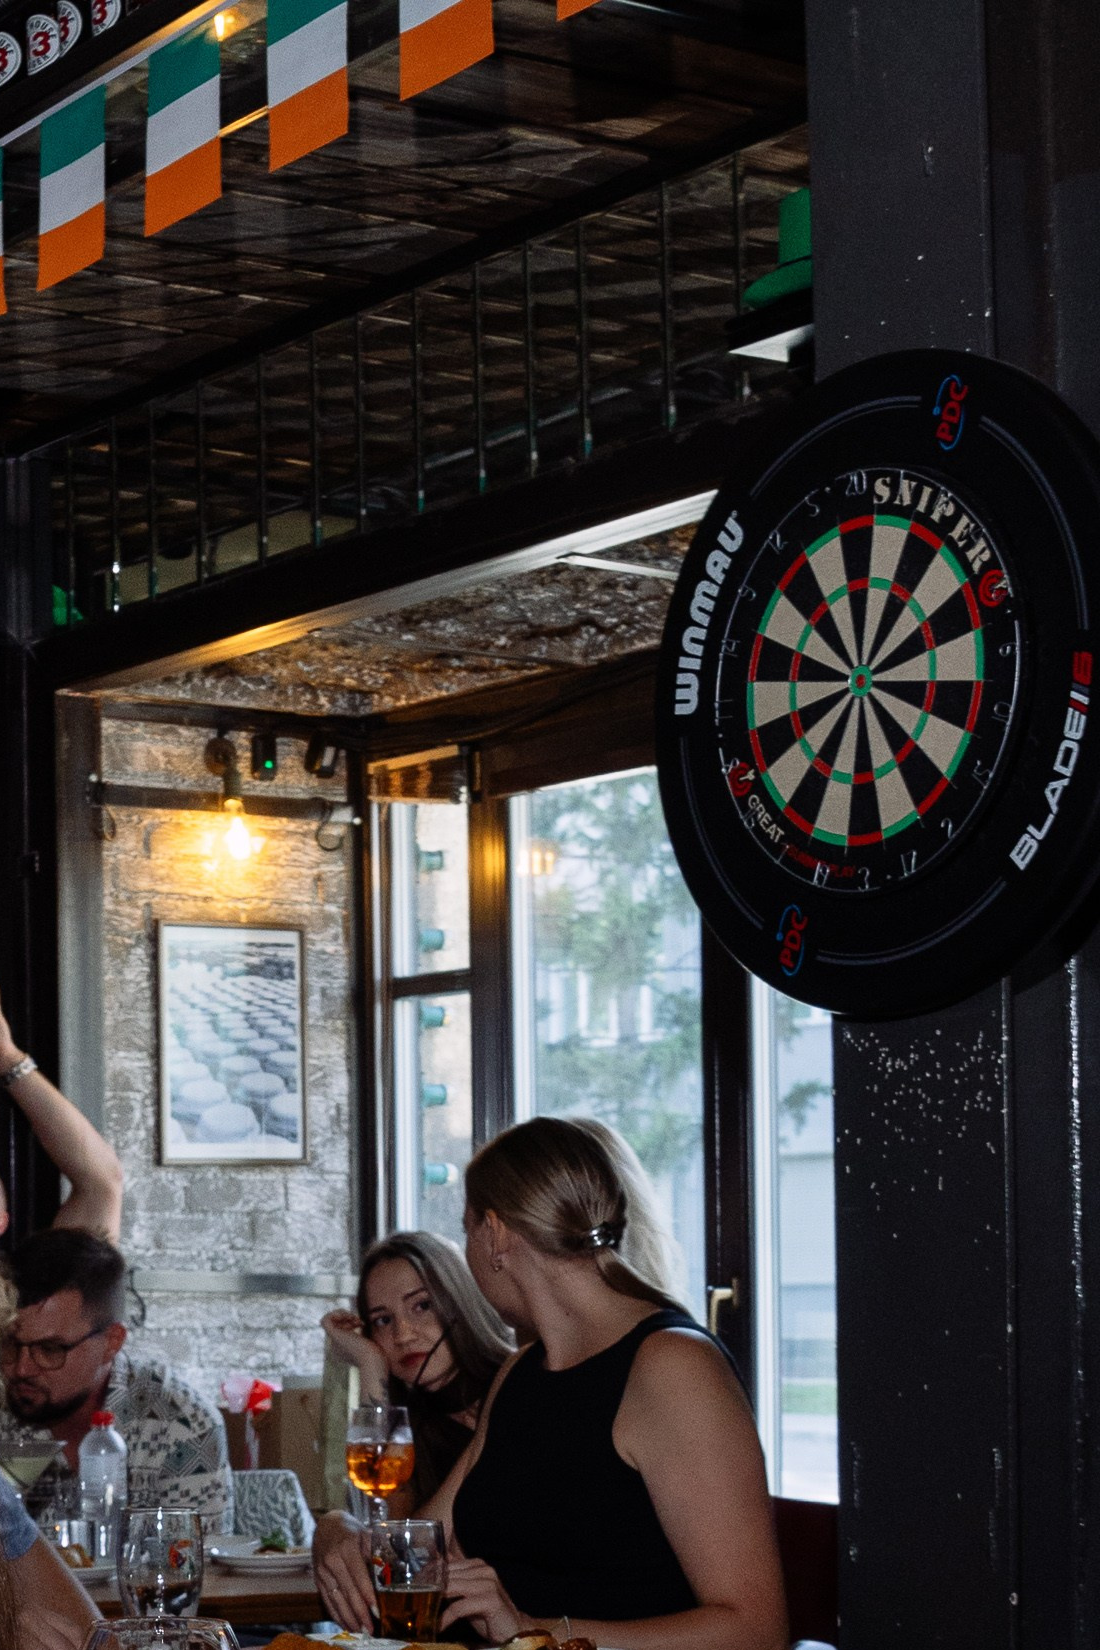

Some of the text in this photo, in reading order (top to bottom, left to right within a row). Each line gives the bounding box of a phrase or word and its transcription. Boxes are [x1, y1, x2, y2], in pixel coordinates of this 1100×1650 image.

[92, 0, 107, 25] 3
[33, 31, 50, 57] 3
[935, 380, 969, 442] PDC
[873, 476, 992, 575] SNIPER
[674, 514, 744, 716] WINMAU
[748, 794, 785, 843] GREAT
[1009, 706, 1087, 871] BLADE
[779, 909, 810, 969] PDC
